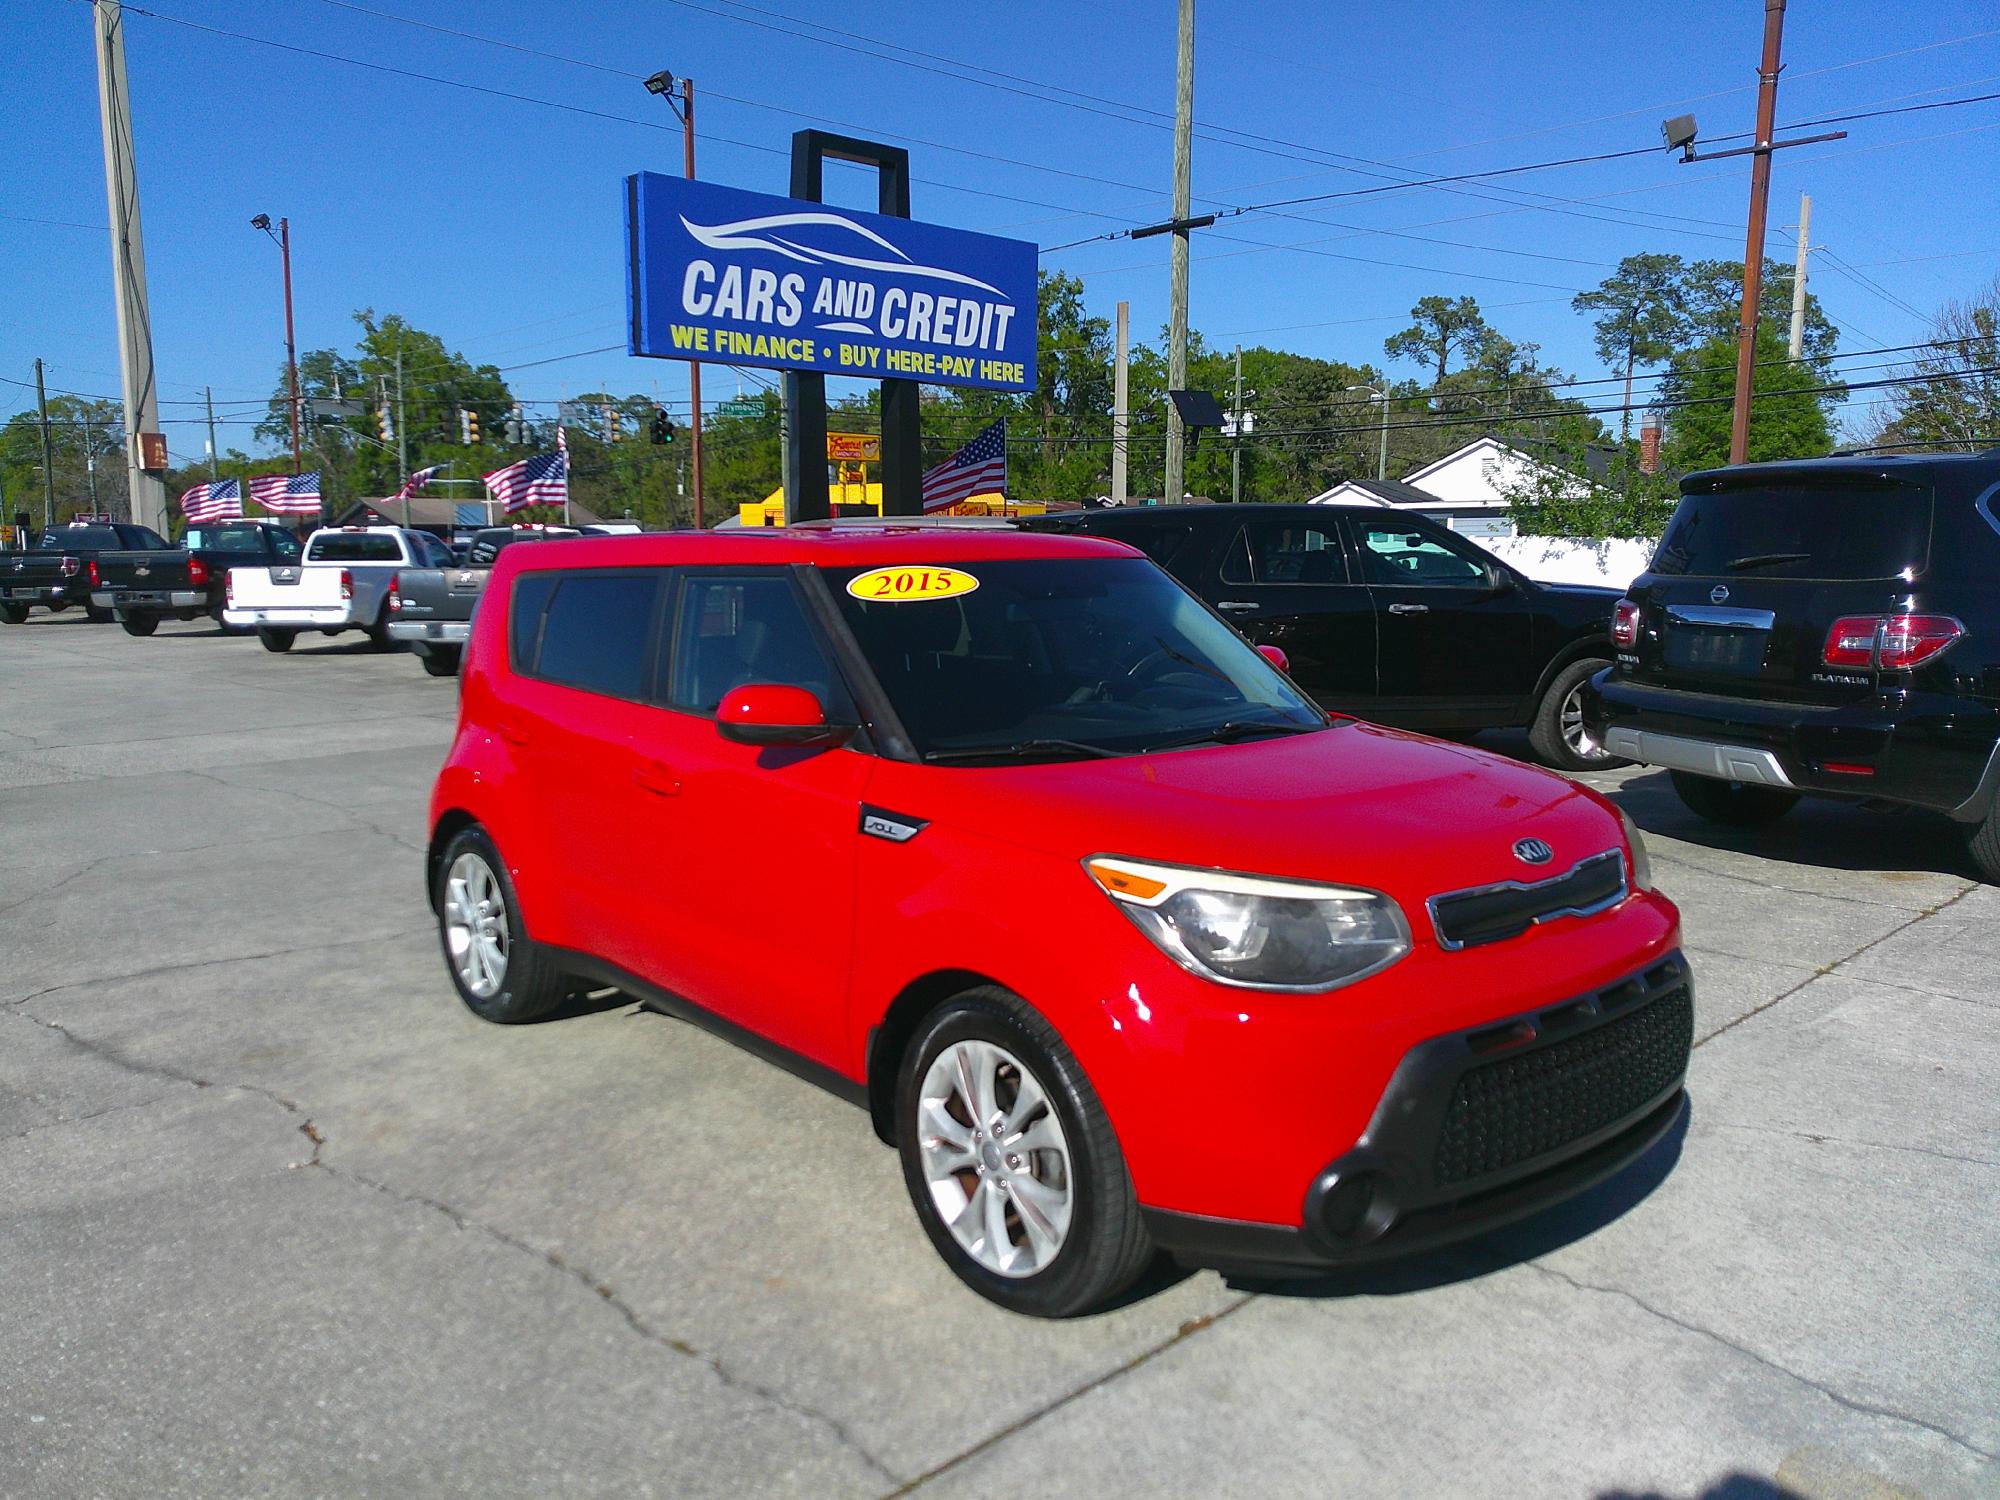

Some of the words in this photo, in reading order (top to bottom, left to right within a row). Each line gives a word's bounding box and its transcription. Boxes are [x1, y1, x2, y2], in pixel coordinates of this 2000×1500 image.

[682, 259, 806, 327] CARS
[812, 277, 875, 319] AND
[880, 287, 1016, 351] CREDIT
[670, 324, 709, 351] WE
[715, 329, 815, 362] FINANCE
[839, 343, 880, 368] BUY
[886, 348, 975, 378] HERE-PAY
[980, 359, 1025, 383] HERE
[874, 572, 951, 596] 2015
[1812, 673, 1869, 685] PLATINUM
[1518, 840, 1552, 860] KIA
